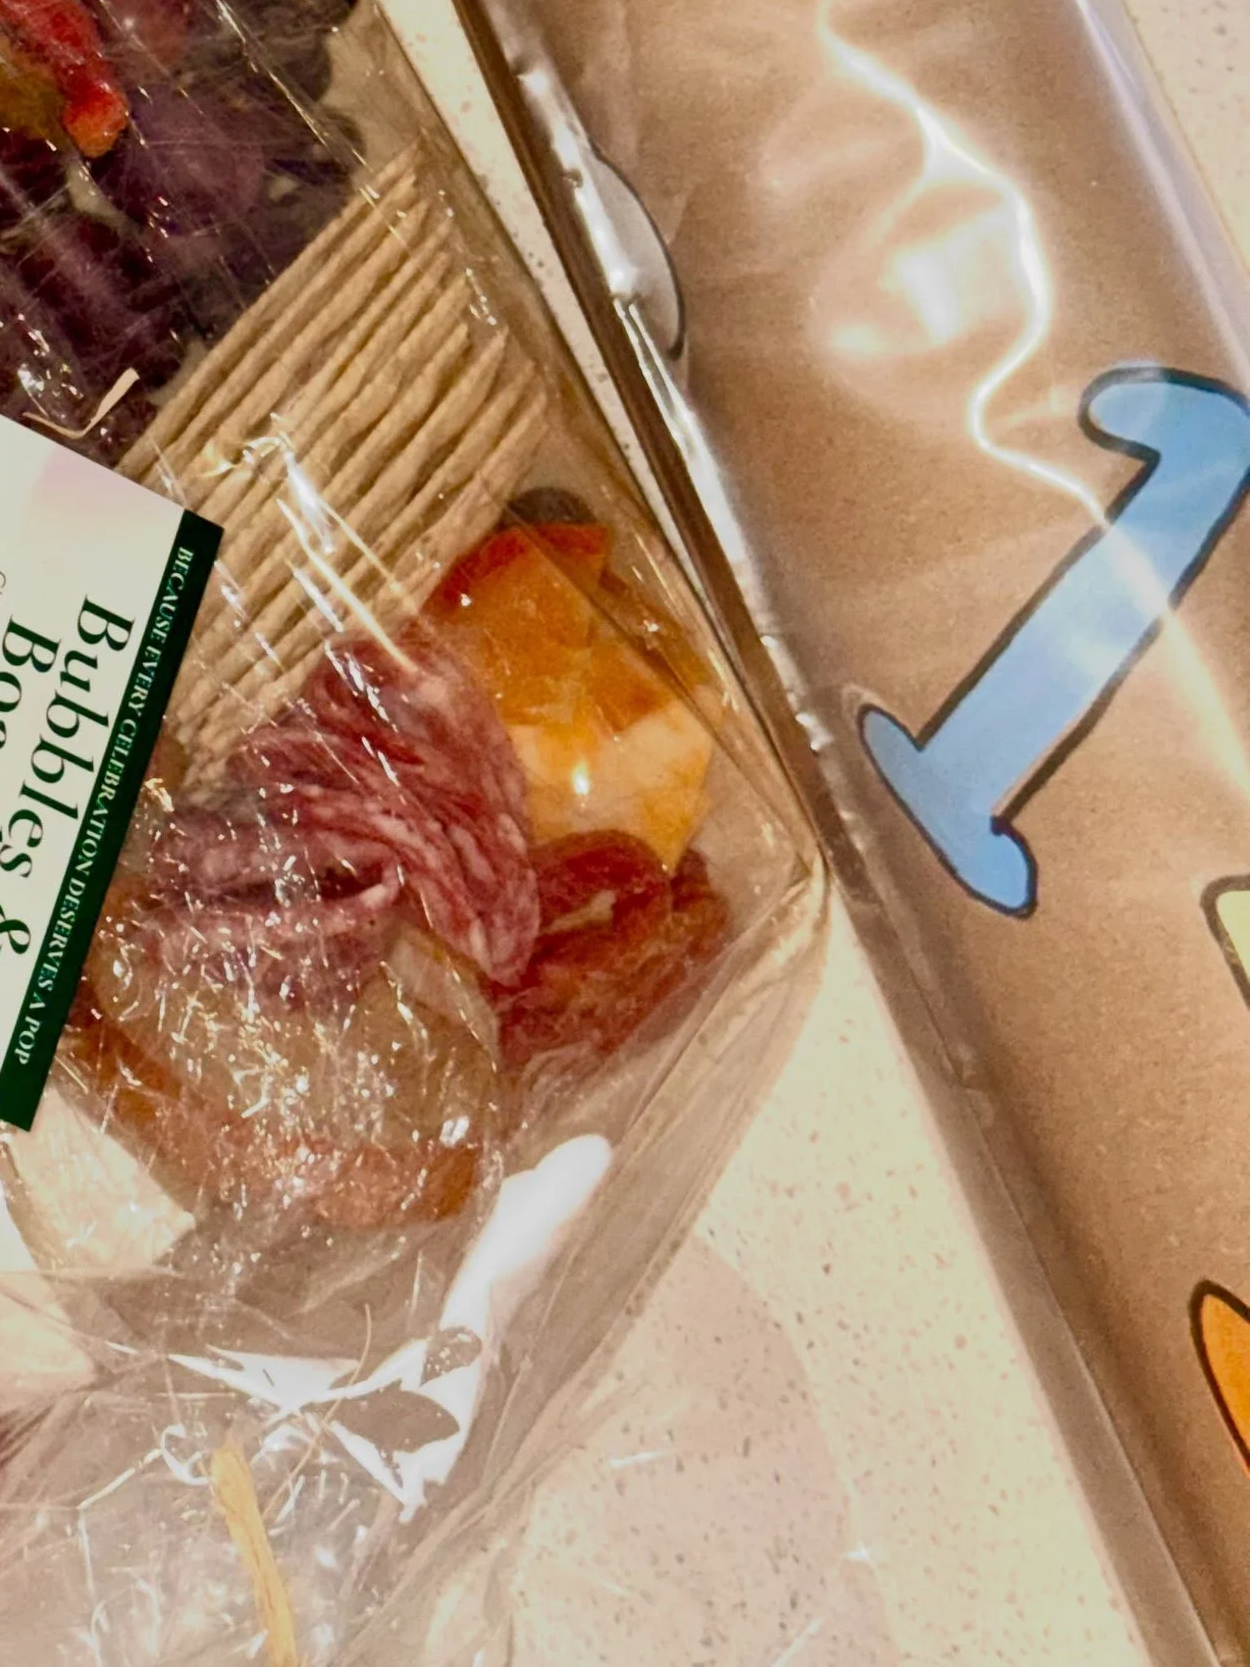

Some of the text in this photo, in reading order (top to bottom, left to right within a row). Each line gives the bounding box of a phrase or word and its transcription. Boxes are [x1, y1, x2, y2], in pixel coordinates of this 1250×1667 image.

[14, 547, 193, 1064] BECAUSE EVERY CELEBRATION DESERVES A POP
